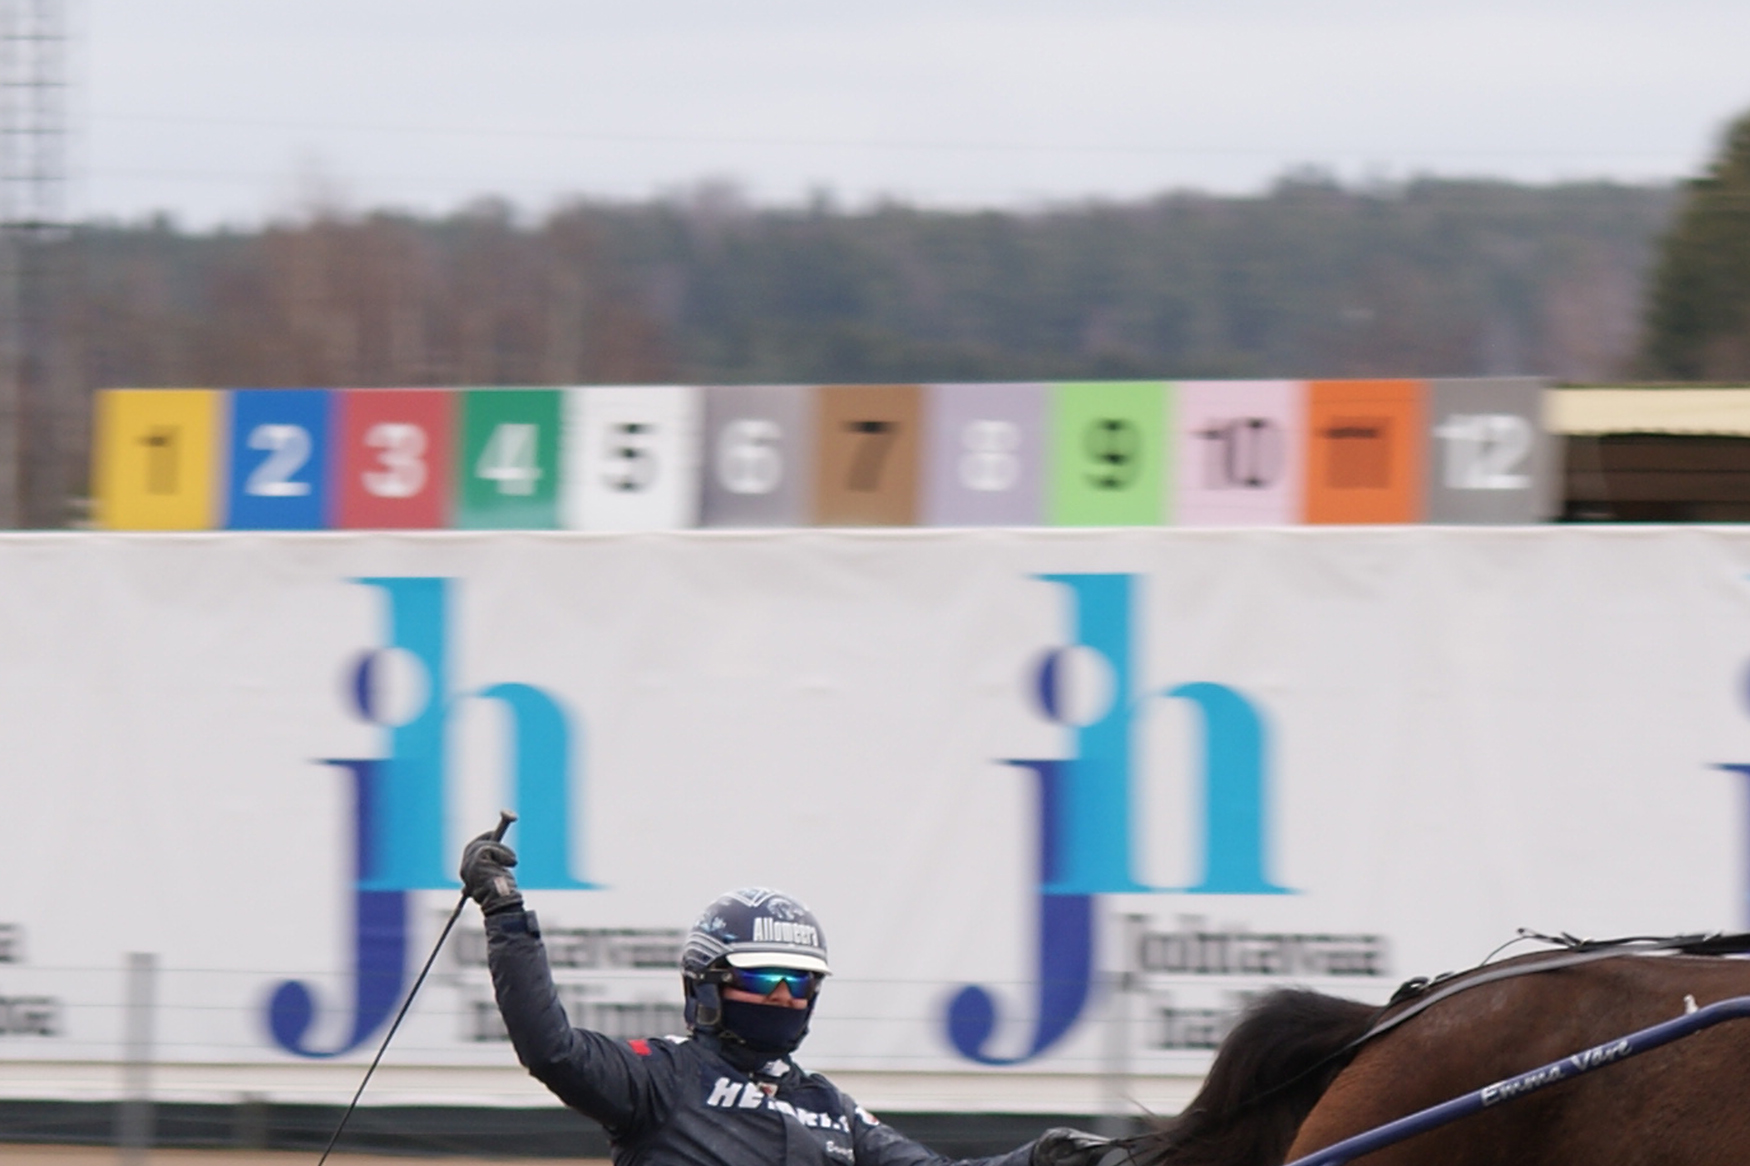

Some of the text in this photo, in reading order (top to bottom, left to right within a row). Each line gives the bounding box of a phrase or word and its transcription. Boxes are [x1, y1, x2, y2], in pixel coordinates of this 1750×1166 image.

[137, 425, 182, 495] 1
[245, 424, 311, 497] 2
[361, 422, 427, 498] 3
[476, 424, 543, 495] 4
[603, 422, 659, 493] 5
[719, 420, 783, 494] 6
[840, 420, 899, 491] 7
[958, 420, 1020, 489] 8
[1082, 418, 1142, 491] 9
[1196, 418, 1283, 489] 10
[1434, 413, 1532, 490] 12
[1480, 1066, 1565, 1107] Emma
